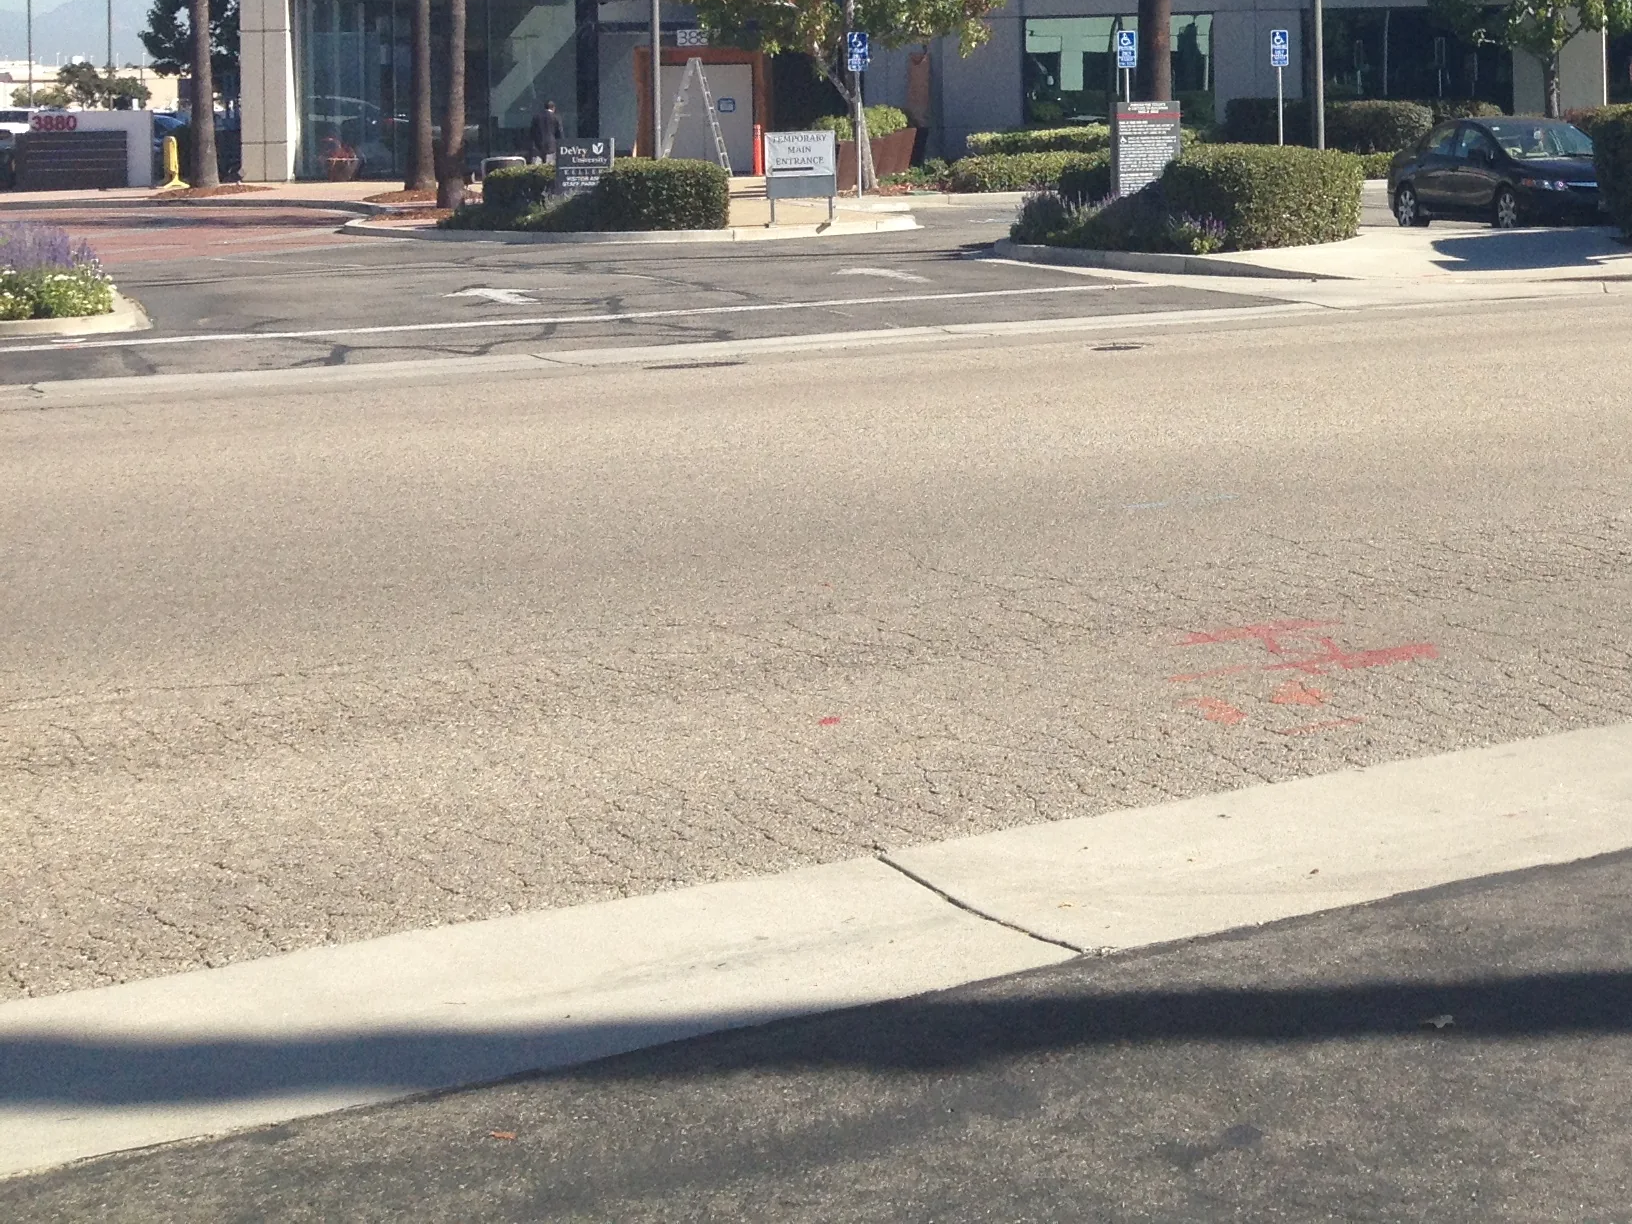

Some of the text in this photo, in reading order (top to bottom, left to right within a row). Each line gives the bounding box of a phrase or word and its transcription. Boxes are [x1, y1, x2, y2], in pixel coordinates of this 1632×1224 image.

[678, 30, 709, 45] 388
[31, 115, 77, 131] 3880
[772, 134, 827, 143] TEMPORARY
[560, 146, 588, 157] DeVry
[788, 146, 812, 154] MAIN
[571, 156, 608, 165] University
[775, 156, 825, 165] ENTRANCE
